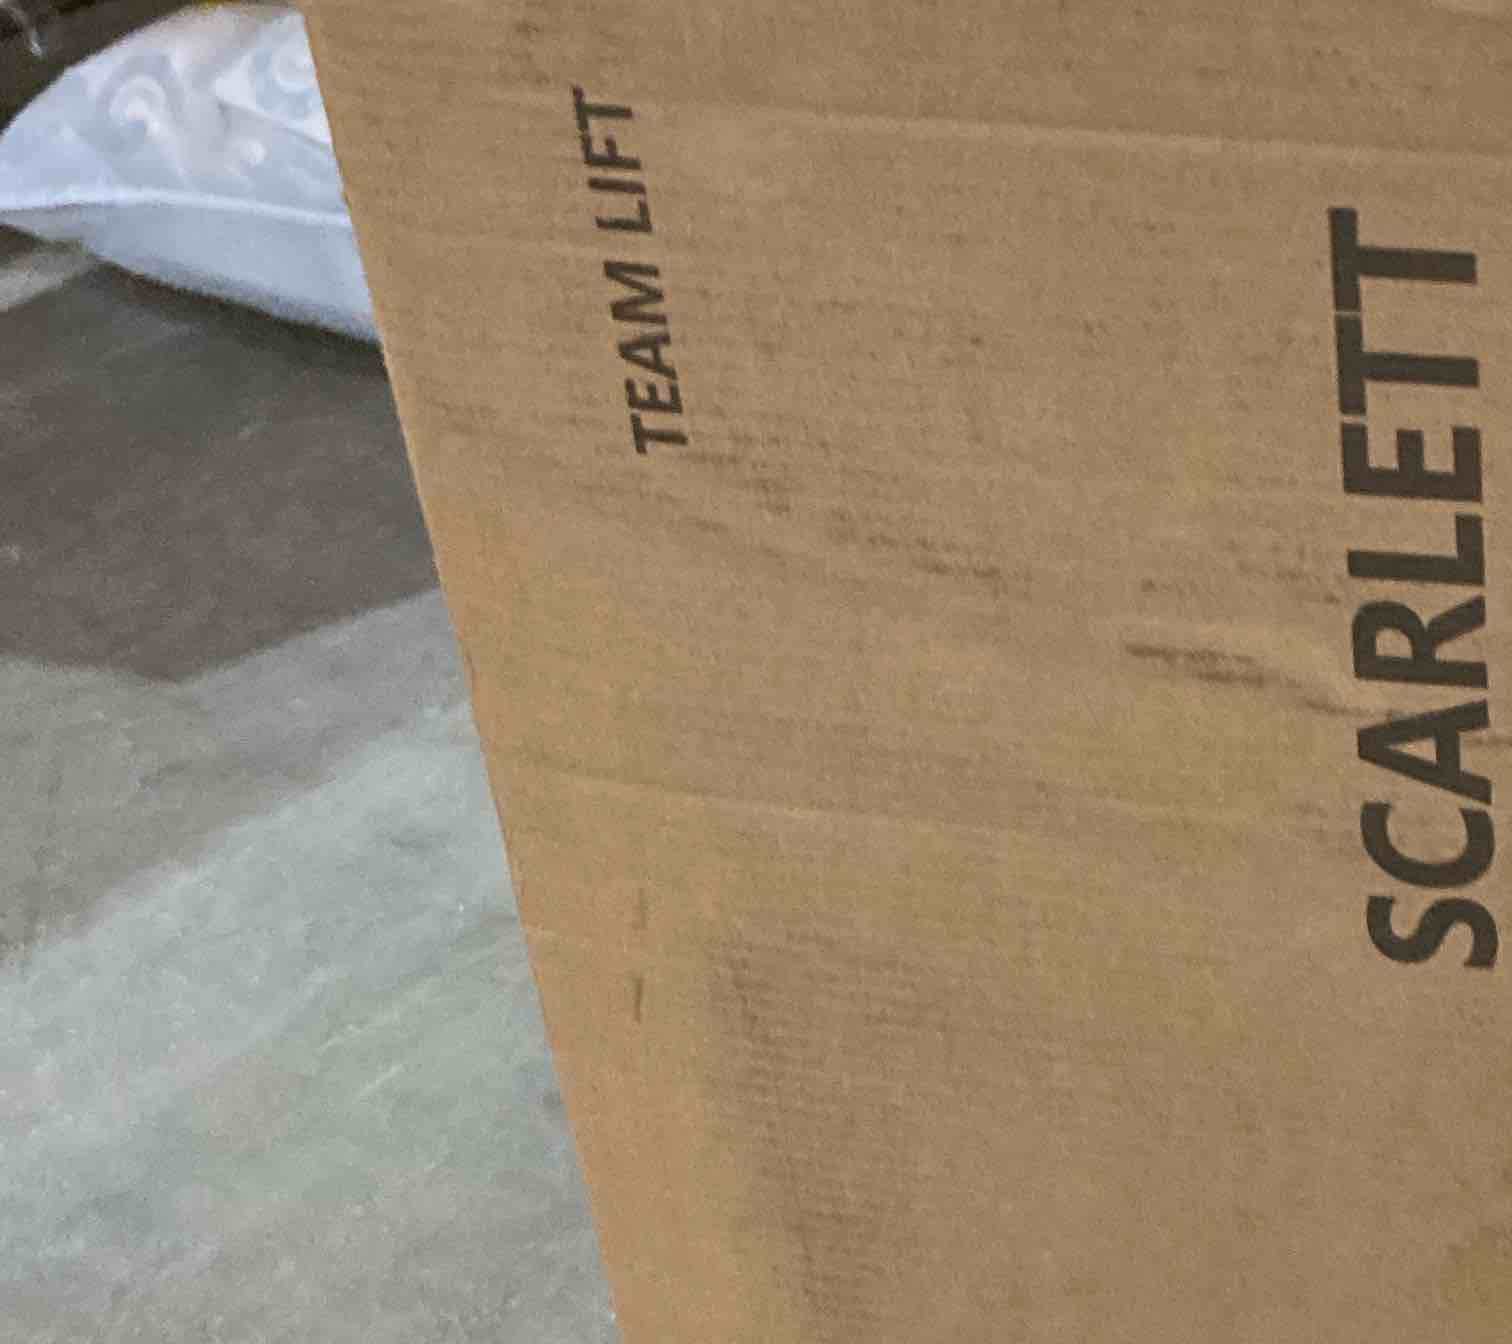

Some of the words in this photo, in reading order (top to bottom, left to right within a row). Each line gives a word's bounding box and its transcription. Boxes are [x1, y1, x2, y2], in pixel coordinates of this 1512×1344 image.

[571, 85, 652, 234] LIFT
[603, 260, 688, 455] TEAM
[1329, 206, 1499, 970] SCARLETT
